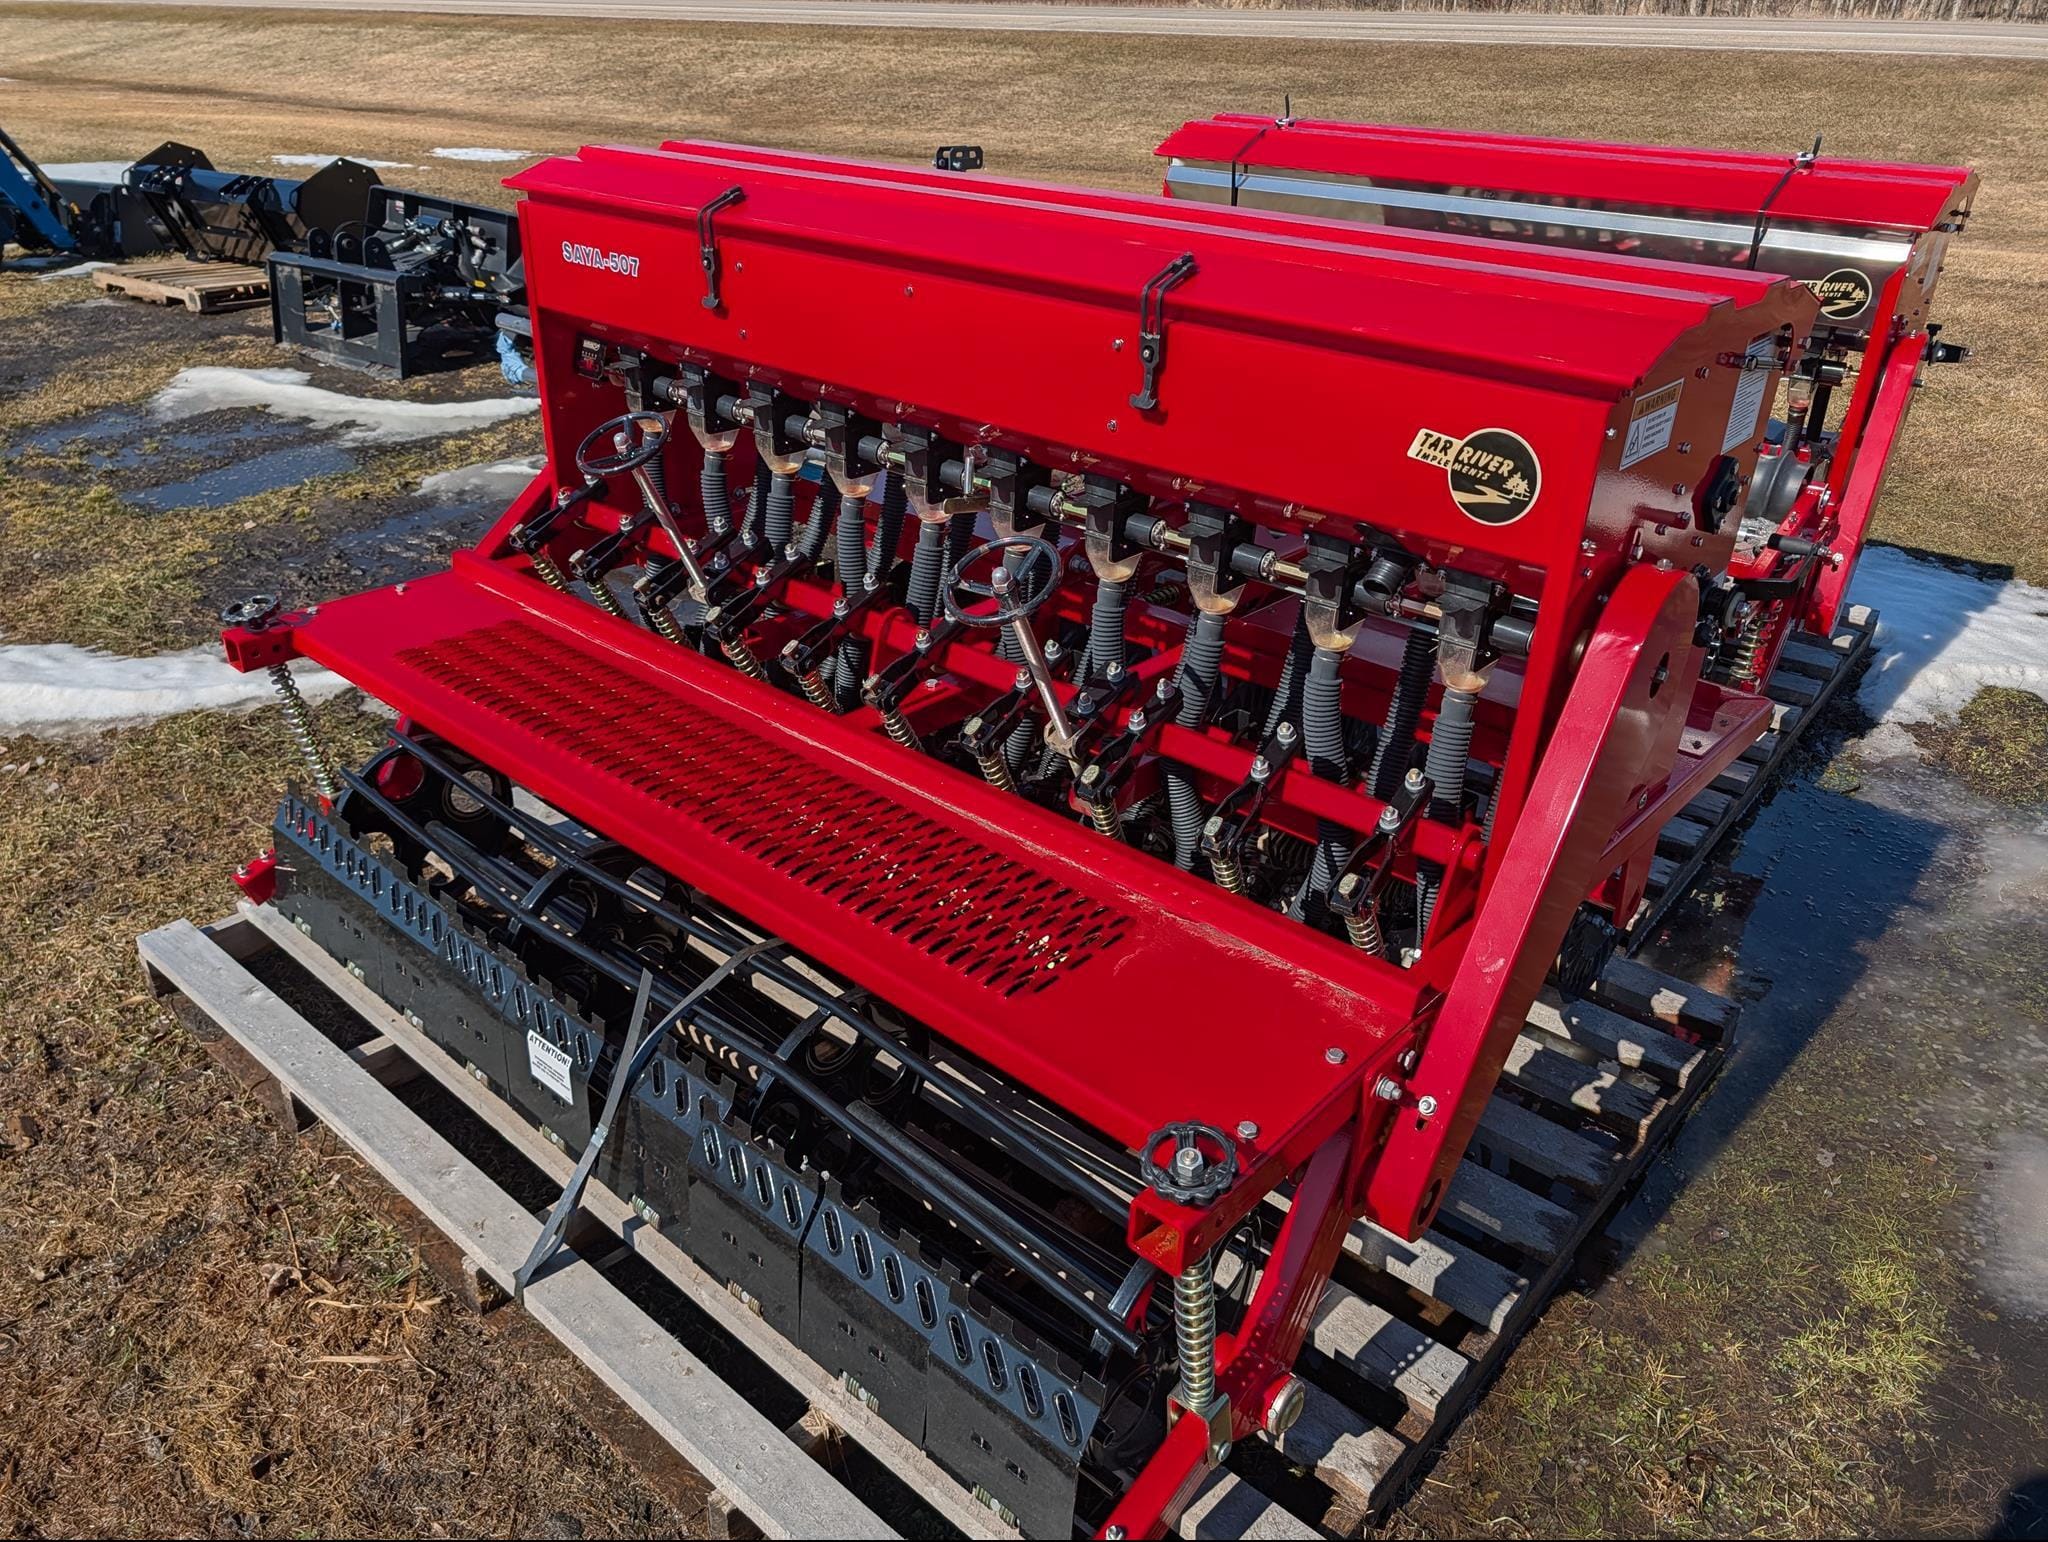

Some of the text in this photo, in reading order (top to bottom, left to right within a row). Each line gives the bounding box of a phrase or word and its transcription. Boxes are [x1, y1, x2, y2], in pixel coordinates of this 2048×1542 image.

[562, 241, 639, 277] SAYA-507
[1821, 282, 1855, 292] RIVER
[1645, 388, 1677, 412] WARNING
[1415, 448, 1490, 480] IMPLEMENTS
[1420, 433, 1514, 477] TAR RIVER
[529, 1034, 570, 1067] ATTENTION!
